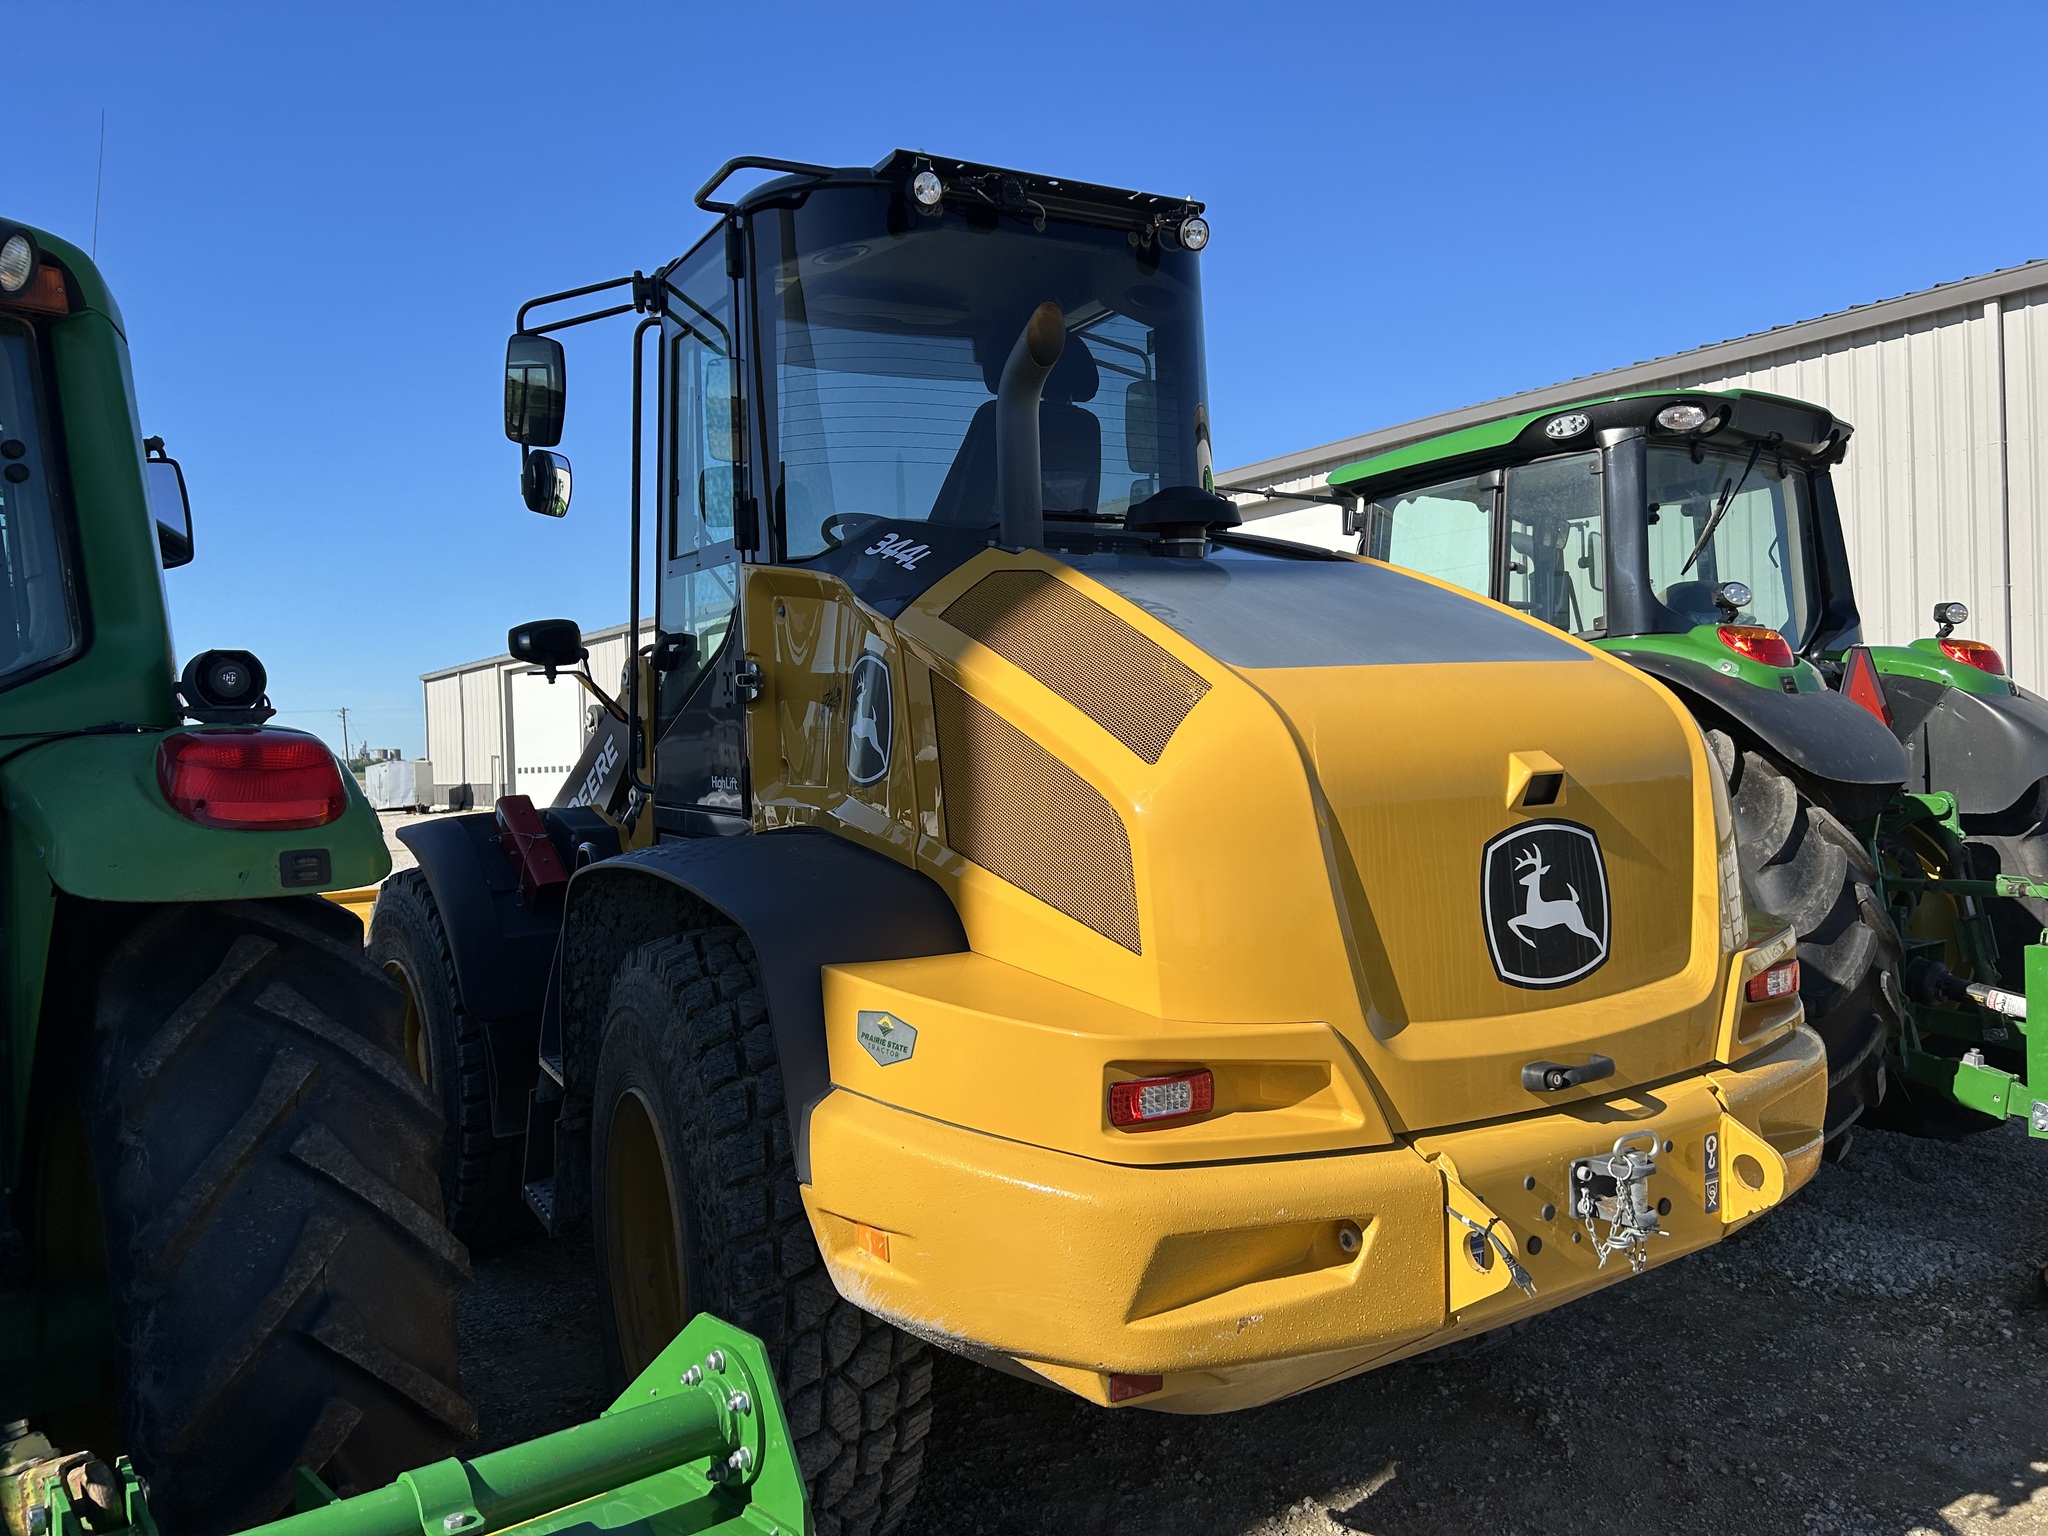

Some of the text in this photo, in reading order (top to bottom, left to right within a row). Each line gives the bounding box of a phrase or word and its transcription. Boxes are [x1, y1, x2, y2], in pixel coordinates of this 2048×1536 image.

[864, 532, 932, 571] 344L
[711, 775, 738, 791] HighLift
[860, 1031, 908, 1053] PRAIRIE STATE
[867, 1042, 900, 1058] TRACTOR
